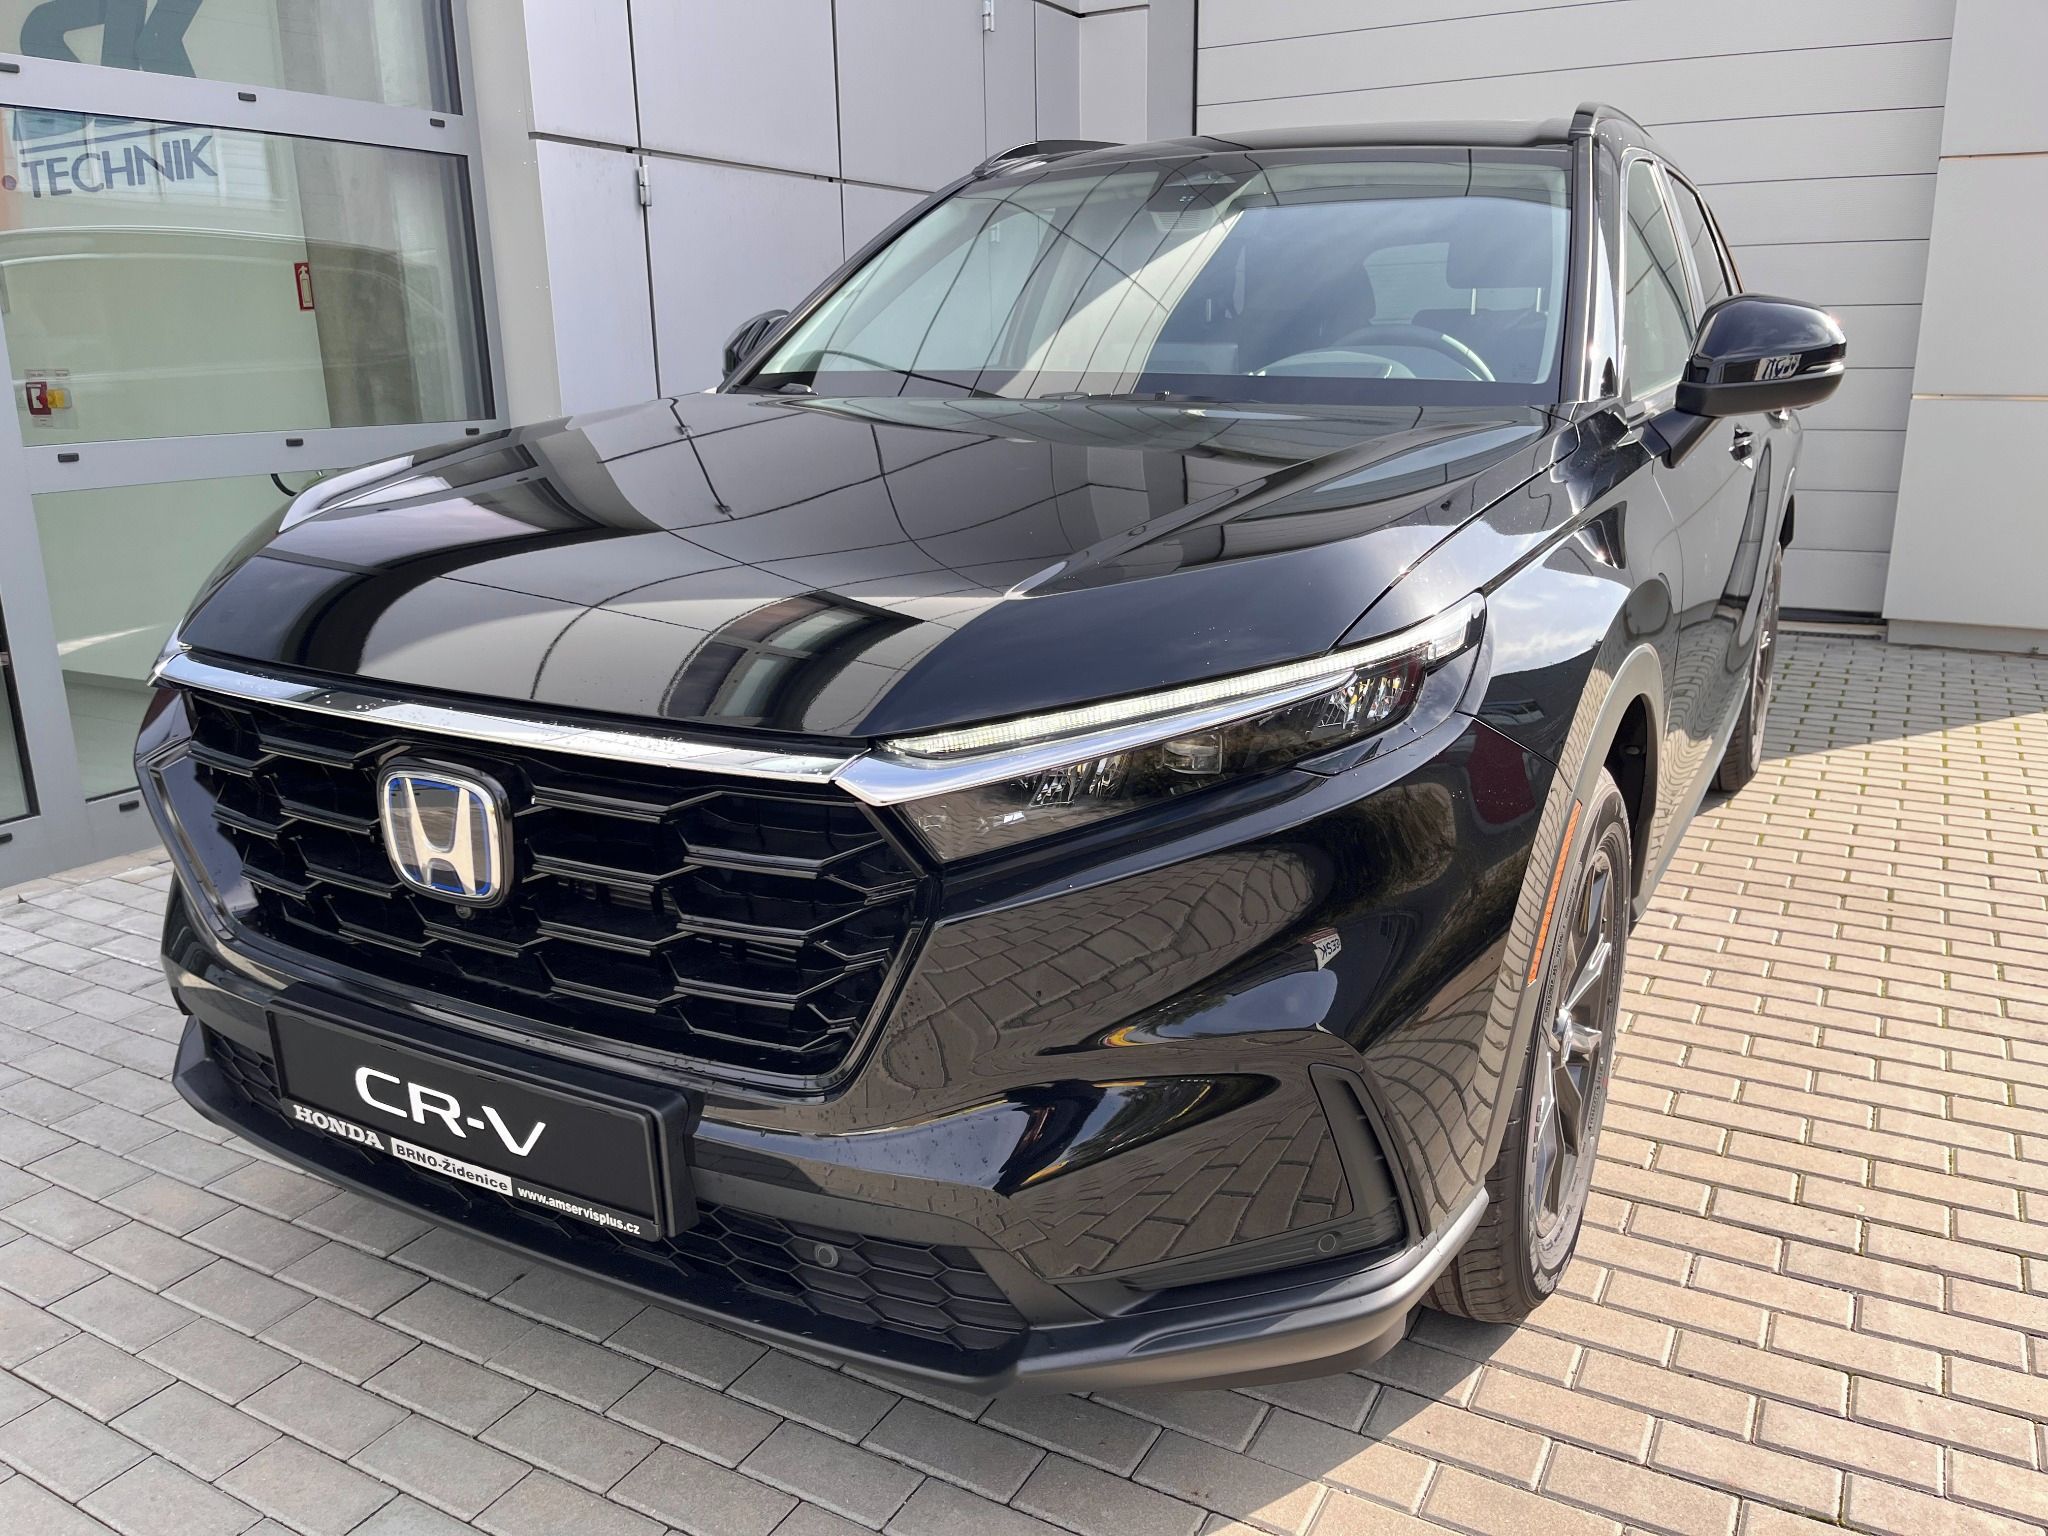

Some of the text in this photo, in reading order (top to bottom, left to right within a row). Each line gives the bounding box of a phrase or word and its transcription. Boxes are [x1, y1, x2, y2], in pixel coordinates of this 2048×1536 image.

[21, 135, 219, 199] TECHNIK
[354, 1066, 547, 1157] CR-V
[293, 1104, 641, 1235] HONDA BRNO-Židenice www.amservisplus.cz
